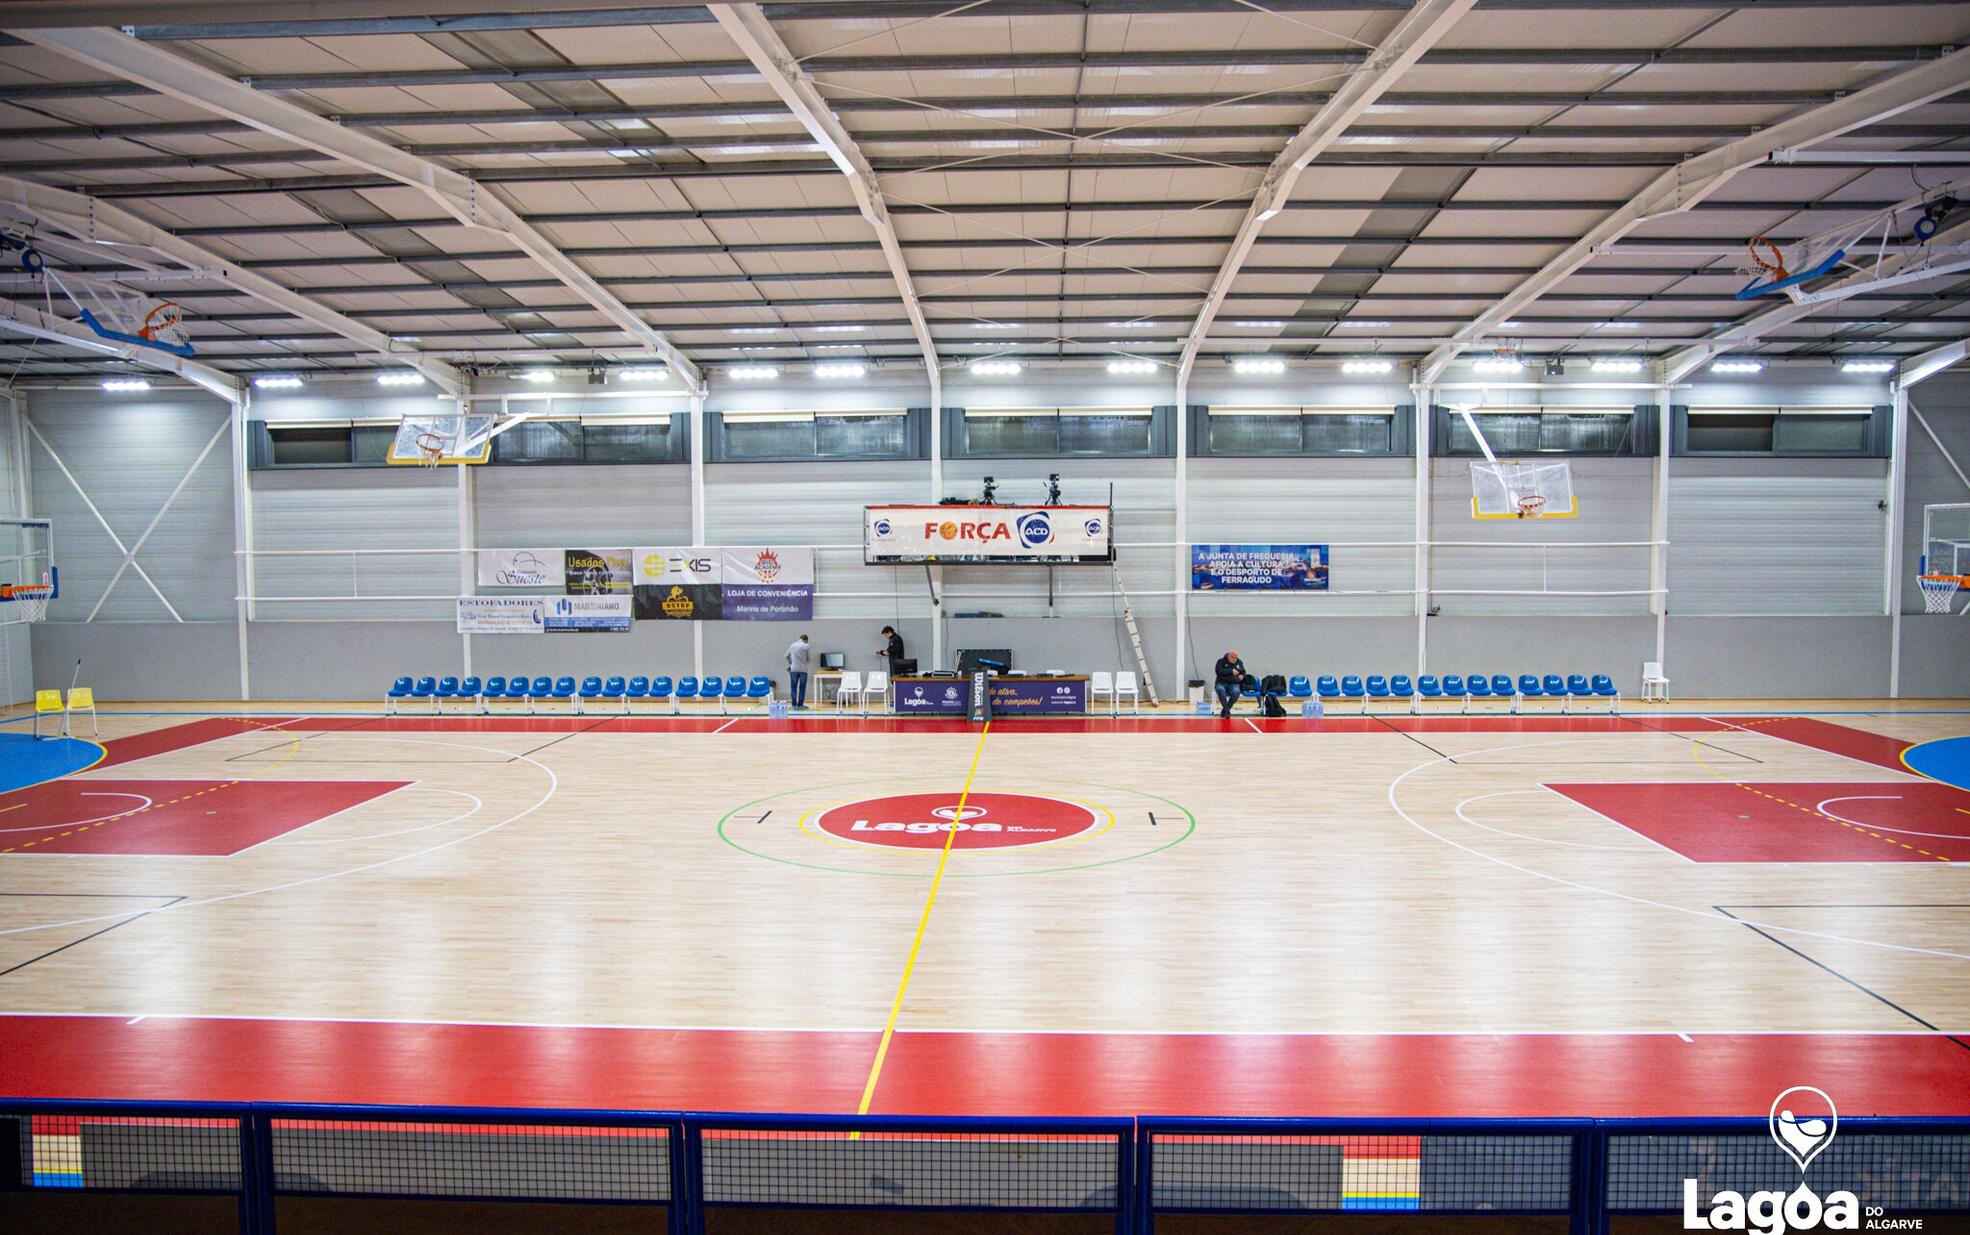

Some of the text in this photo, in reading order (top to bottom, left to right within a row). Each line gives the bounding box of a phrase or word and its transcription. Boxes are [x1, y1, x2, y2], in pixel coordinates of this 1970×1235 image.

[1249, 552, 1296, 560] FREGUESIA
[568, 556, 605, 568] Usados
[757, 589, 808, 597] CONVENIÊNCIA
[574, 602, 620, 610] MARTINIANO
[770, 605, 799, 613] Portimão
[851, 820, 1002, 834] Lagoa
